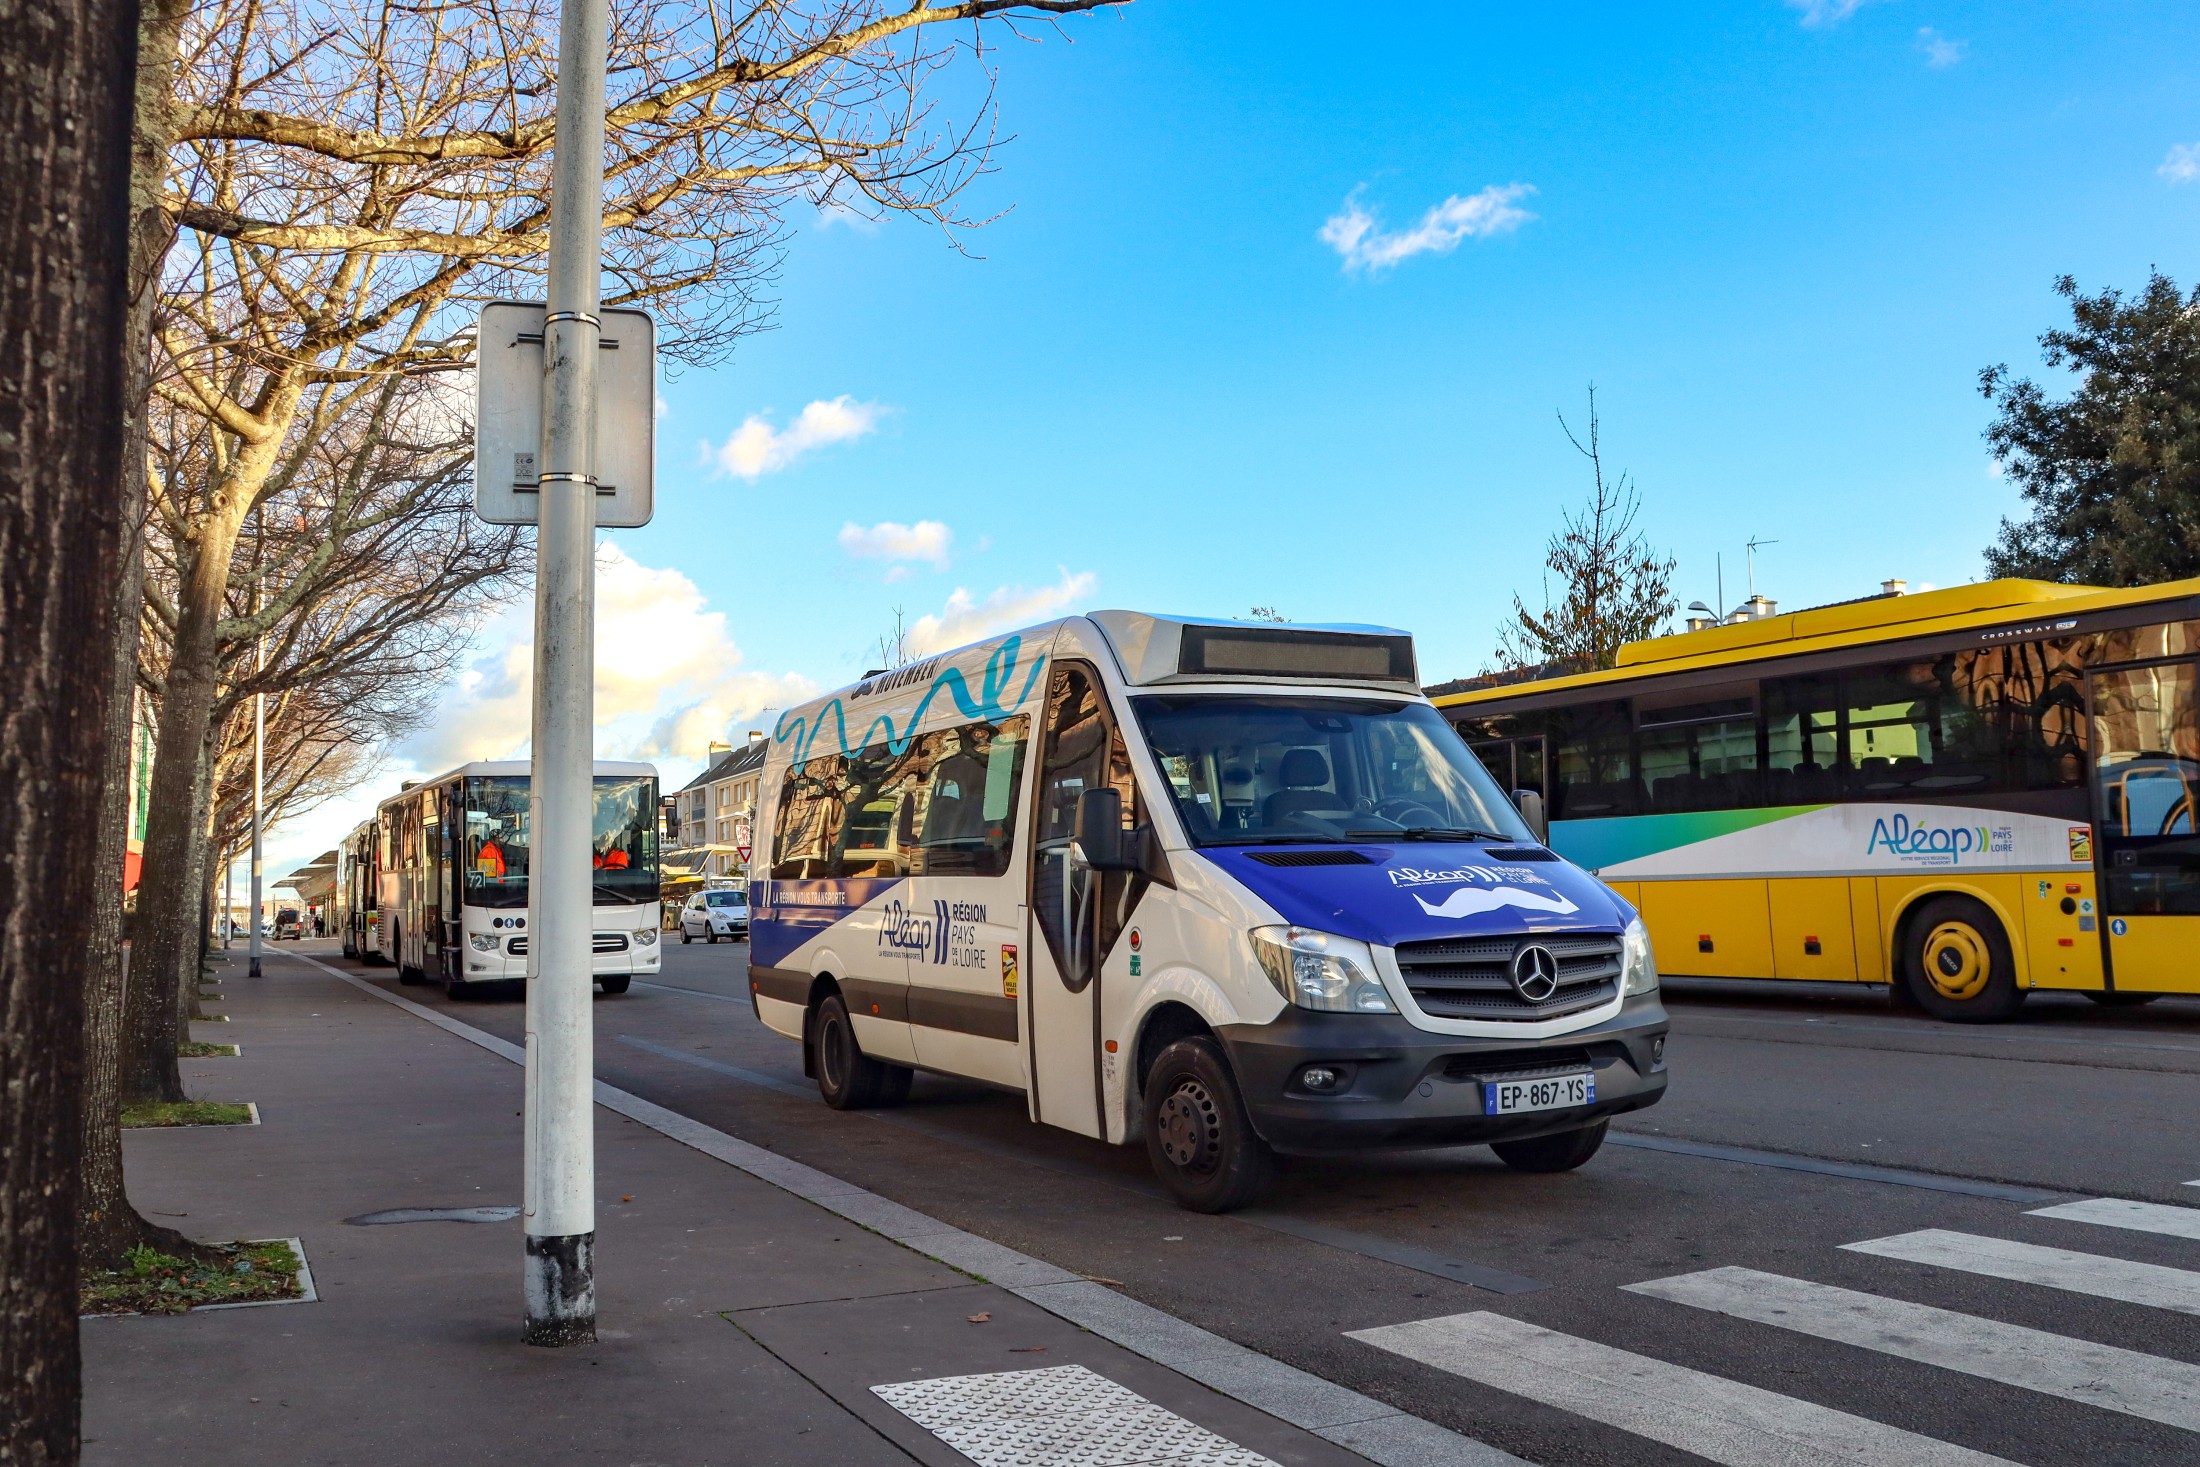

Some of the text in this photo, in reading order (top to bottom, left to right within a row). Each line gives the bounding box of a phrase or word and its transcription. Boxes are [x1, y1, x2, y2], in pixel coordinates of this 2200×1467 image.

[1981, 625, 2051, 639] CROSSWAY
[875, 657, 939, 695] MOVEMBER
[1867, 813, 1972, 864] Aléop
[1992, 831, 2012, 840] PAYS
[1991, 843, 2013, 852] LOIRE
[467, 873, 482, 888] 72
[772, 890, 845, 905] LA RÉGION VOUS TRANSPORTE
[953, 900, 986, 923] RÉGION
[878, 899, 931, 963] Aléop
[952, 925, 975, 945] PAYS
[952, 947, 958, 956] DE
[960, 948, 986, 969] LOIRE
[952, 958, 958, 966] LA
[1942, 952, 1958, 970] IVECO
[1501, 1079, 1584, 1109] EP-867-YS
